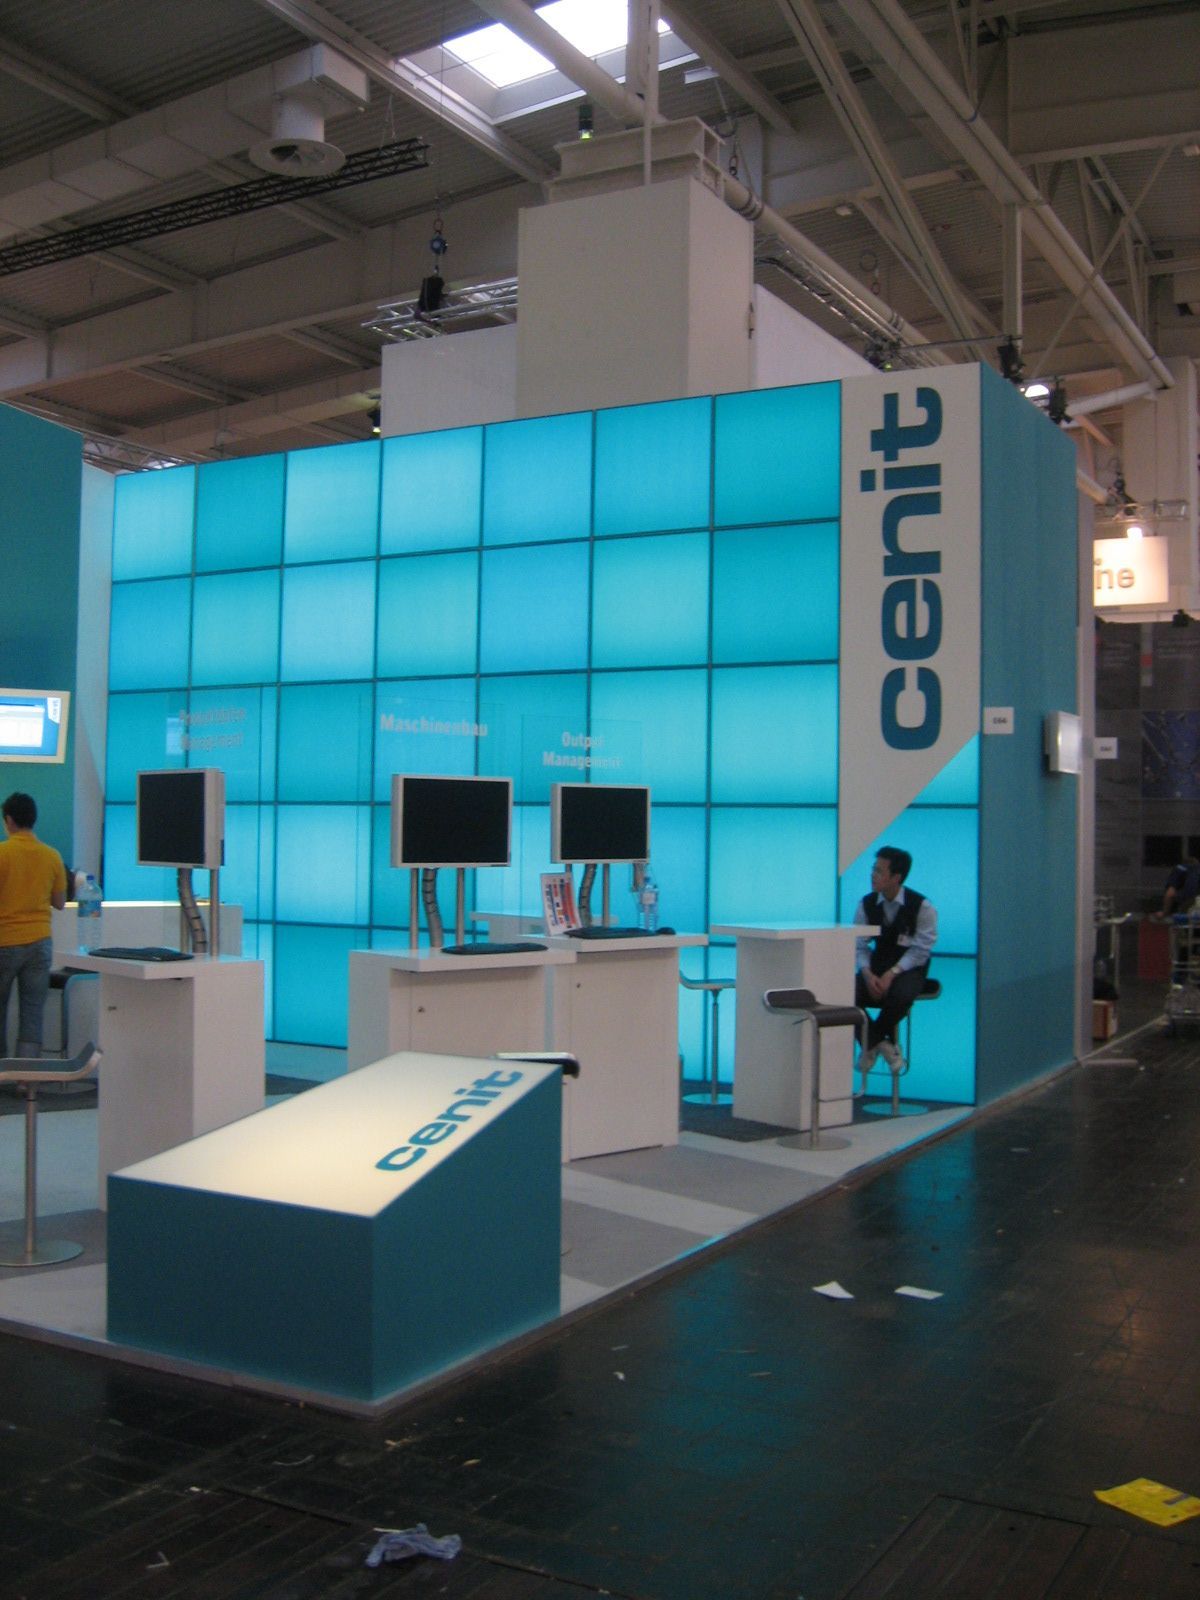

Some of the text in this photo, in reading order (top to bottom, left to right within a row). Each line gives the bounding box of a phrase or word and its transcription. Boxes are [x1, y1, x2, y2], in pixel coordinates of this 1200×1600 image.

[860, 387, 943, 751] cenit
[380, 713, 488, 736] Maschinenbau
[375, 1070, 523, 1171] cenit
